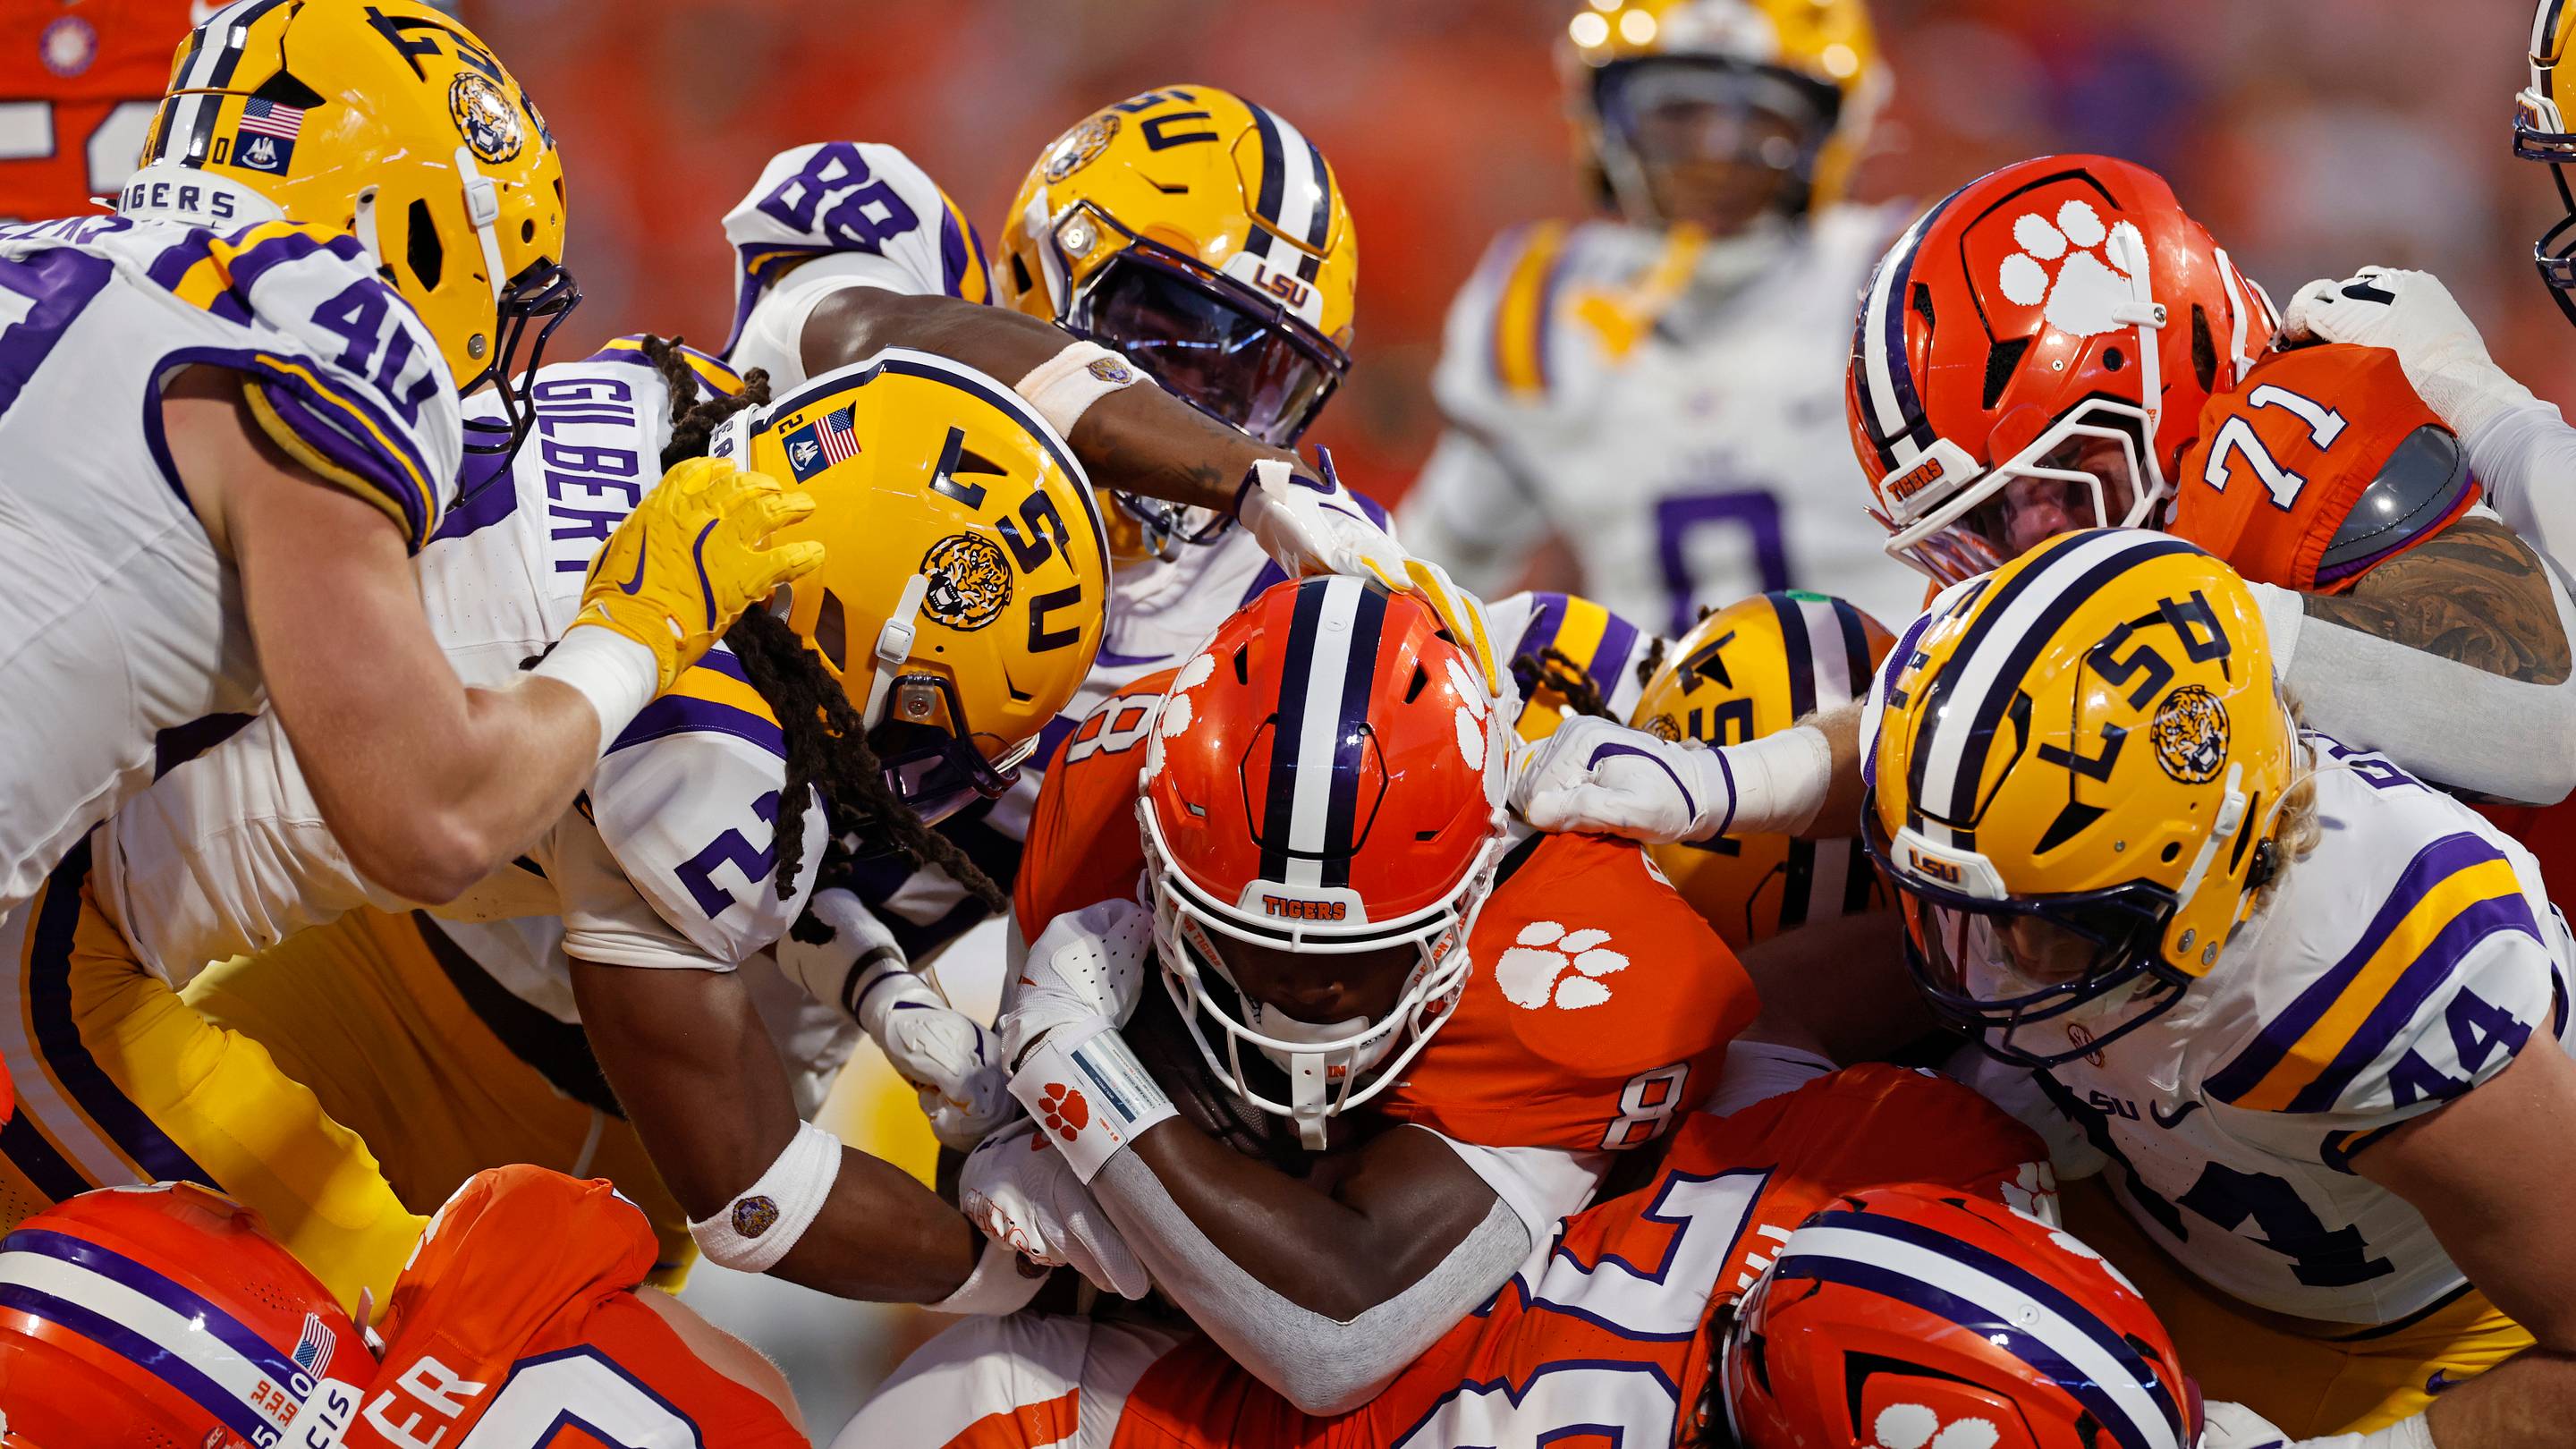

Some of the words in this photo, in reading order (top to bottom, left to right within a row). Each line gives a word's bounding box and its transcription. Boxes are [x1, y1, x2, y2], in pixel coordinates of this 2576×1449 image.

[118, 182, 235, 219] IGERS
[756, 141, 920, 255] 88
[1252, 263, 1309, 309] LSU
[309, 276, 440, 430] 40
[777, 413, 804, 435] 2
[2203, 382, 2351, 514] 71
[1885, 457, 1945, 502] TIGERS
[927, 425, 1083, 654] LSU
[2036, 589, 2233, 784] LSU
[1908, 845, 1962, 884] LSU
[1262, 894, 1347, 921] TIGERS
[1193, 932, 1223, 967] TIGERS
[2386, 984, 2533, 1111] 44
[1599, 1062, 1691, 1152] 8
